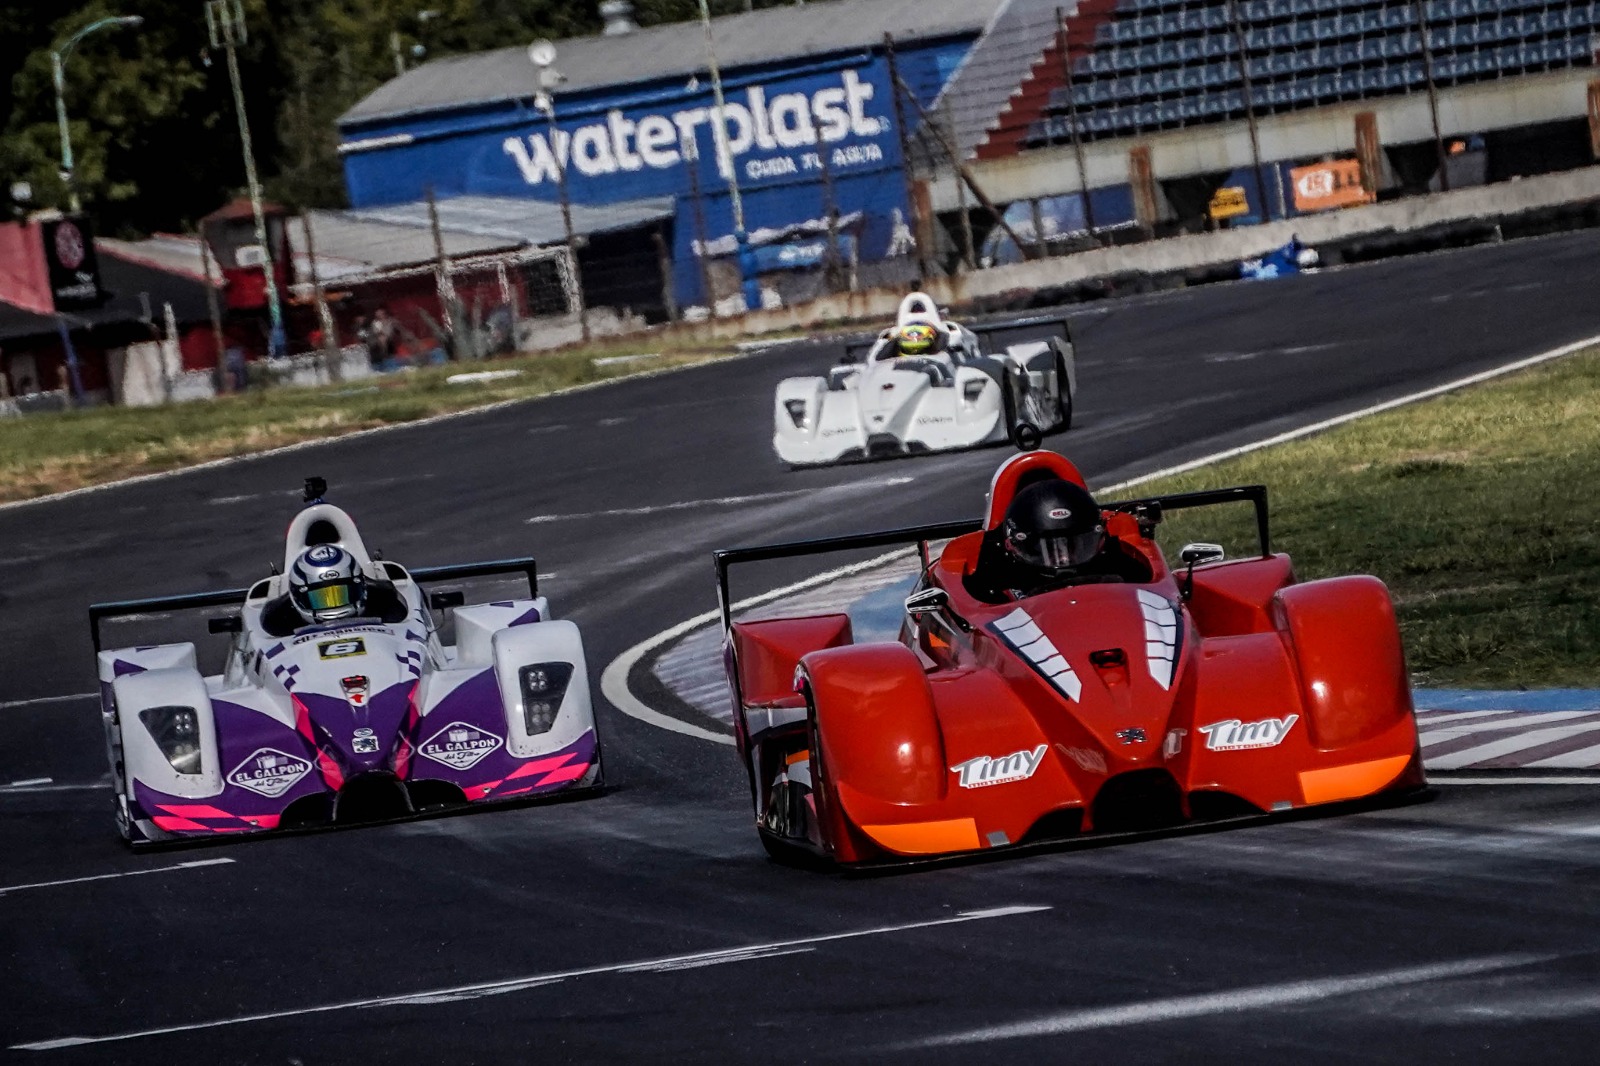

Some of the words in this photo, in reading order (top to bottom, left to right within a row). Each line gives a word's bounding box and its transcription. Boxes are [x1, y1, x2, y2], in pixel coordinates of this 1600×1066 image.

[503, 69, 874, 182] waterplast
[427, 744, 443, 754] EL
[445, 738, 496, 752] GALPON
[1199, 713, 1299, 748] Timy
[235, 772, 252, 783] EL
[254, 762, 305, 779] GALPON
[951, 745, 1048, 785] Timy
